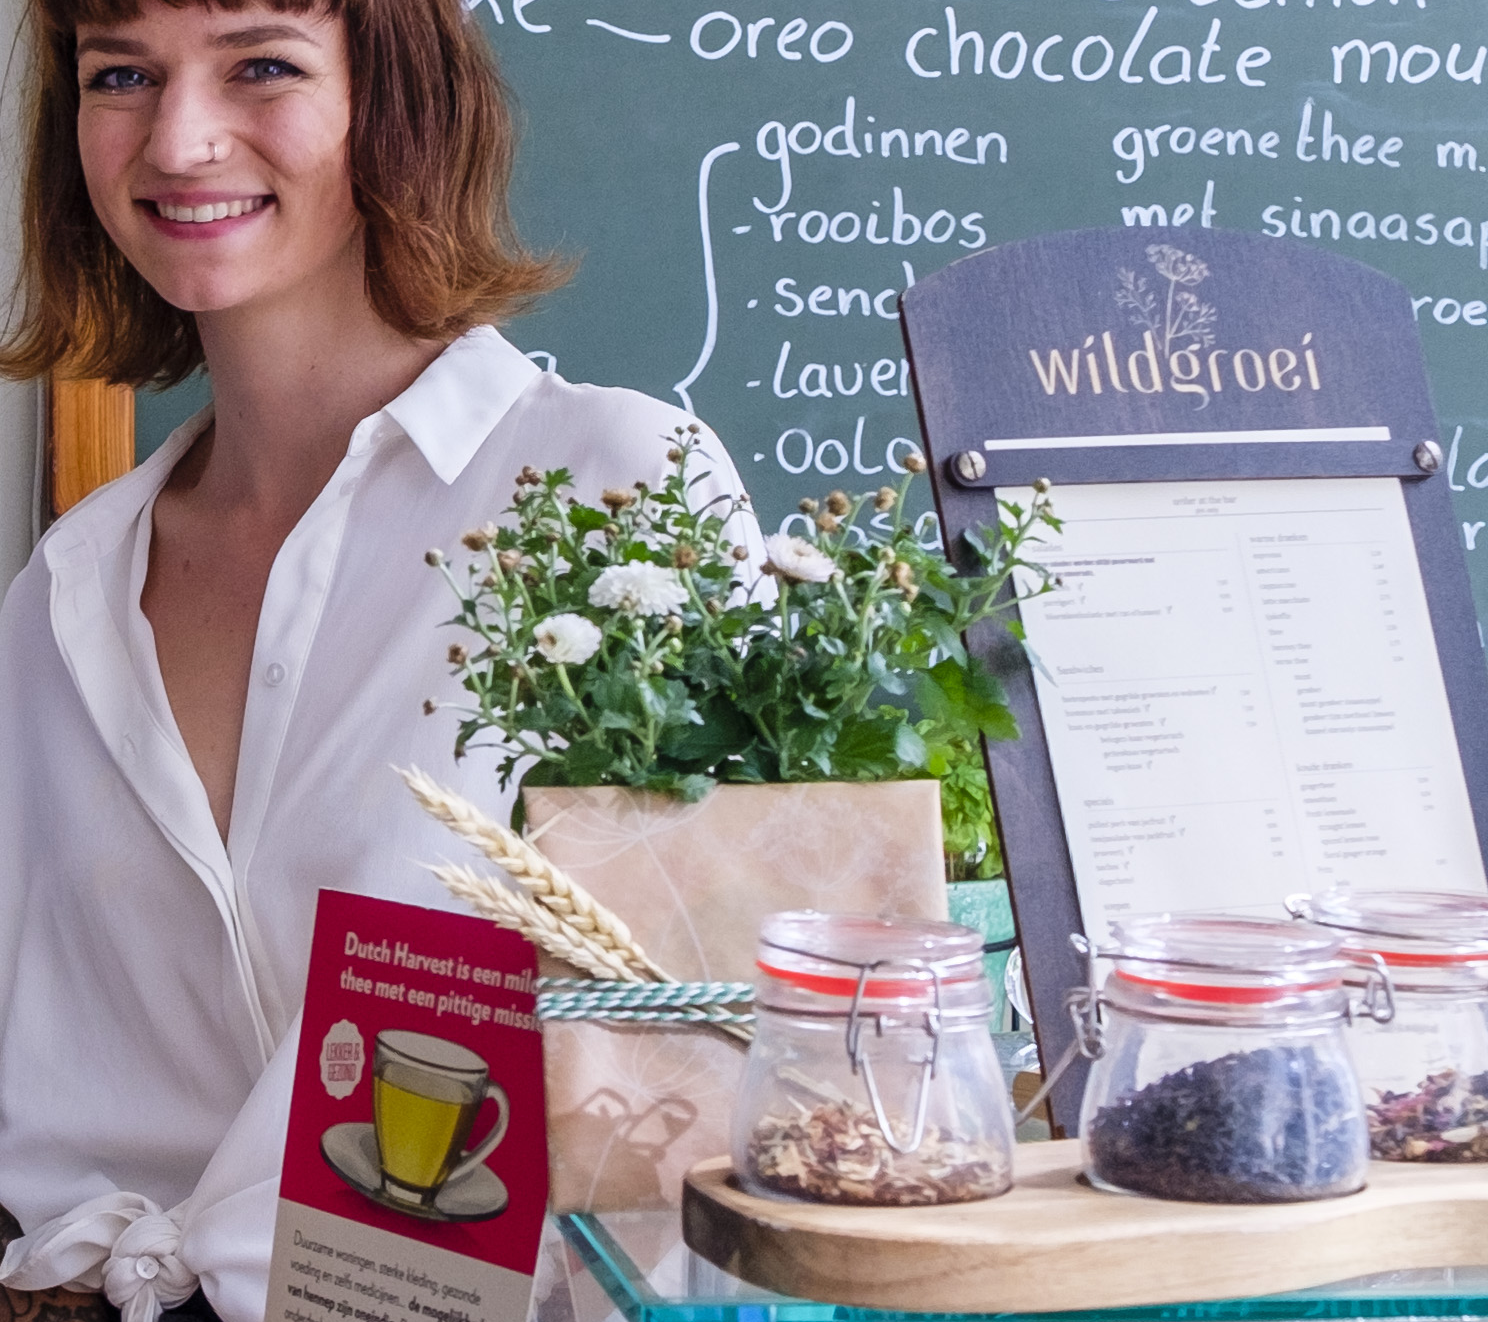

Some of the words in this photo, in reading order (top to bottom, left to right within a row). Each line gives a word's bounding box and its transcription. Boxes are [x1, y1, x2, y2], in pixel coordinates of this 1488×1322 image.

[905, 6, 1273, 89] chocolate
[753, 96, 1008, 214] godinnen
[1112, 120, 1281, 184] groene
[1295, 97, 1404, 168] thee
[1436, 139, 1486, 173] m.
[1028, 331, 1323, 412] wildgroei
[340, 966, 373, 995] thee
[375, 981, 406, 1002] met
[407, 988, 435, 1010] een
[436, 990, 492, 1026] pittige
[344, 930, 391, 965] Dutch
[393, 940, 454, 977] Harvest
[456, 956, 470, 981] is
[472, 966, 502, 988] een
